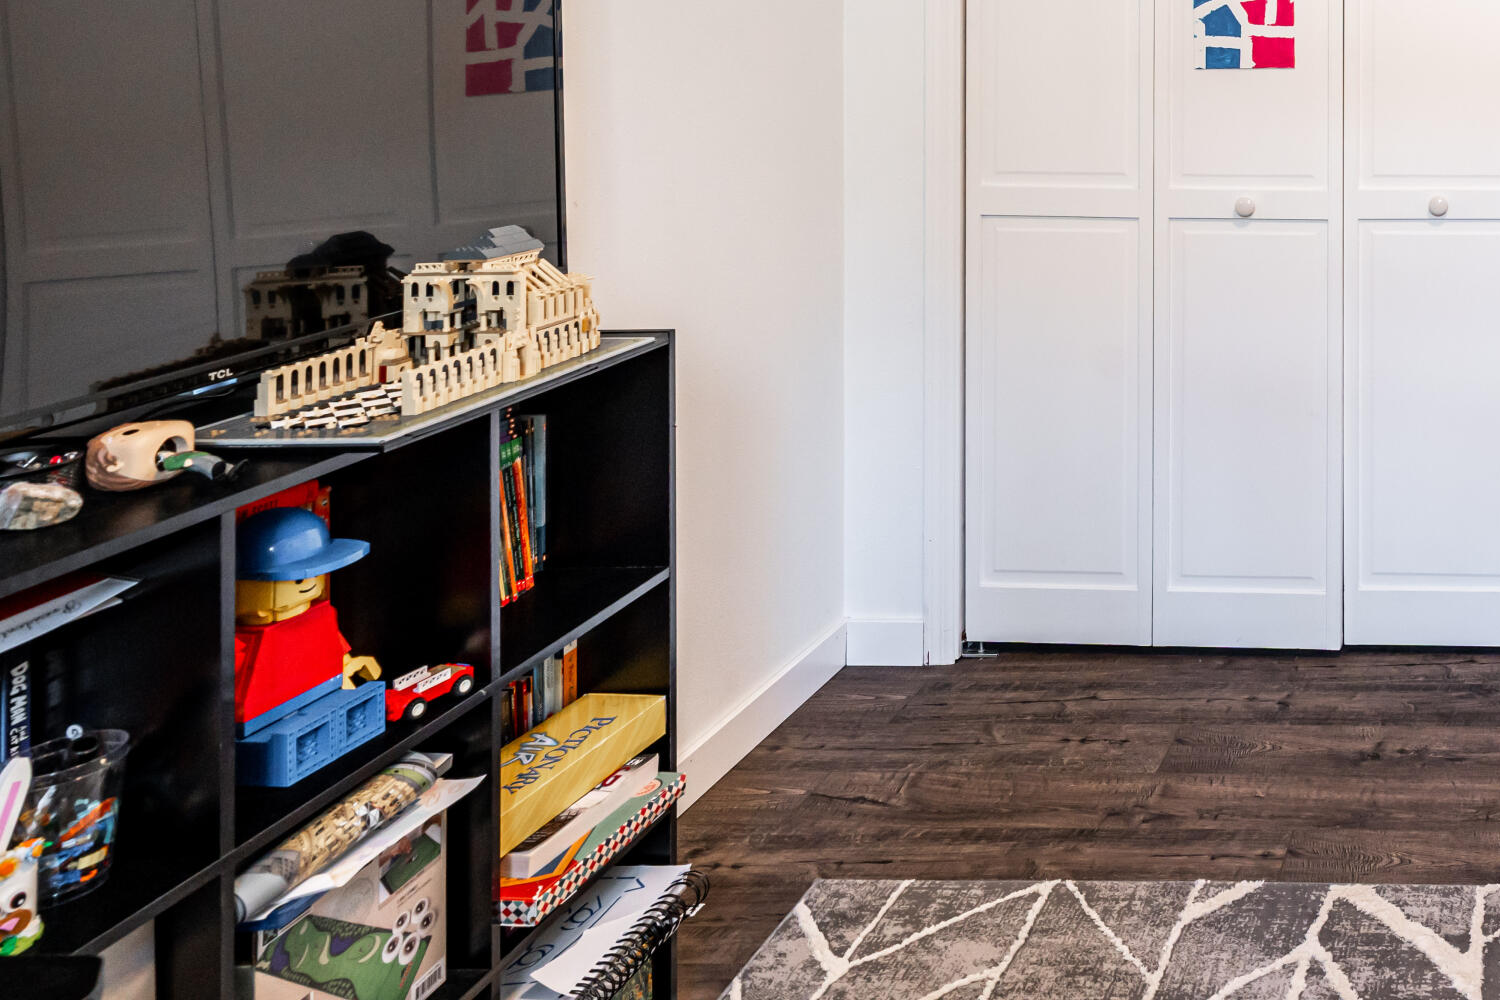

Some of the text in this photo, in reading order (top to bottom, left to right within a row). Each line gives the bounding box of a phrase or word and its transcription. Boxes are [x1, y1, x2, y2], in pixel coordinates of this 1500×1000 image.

[208, 368, 233, 381] TCL
[10, 661, 29, 726] DOG MAN
[502, 715, 618, 795] PICTIONARY
[503, 732, 559, 766] AIR
